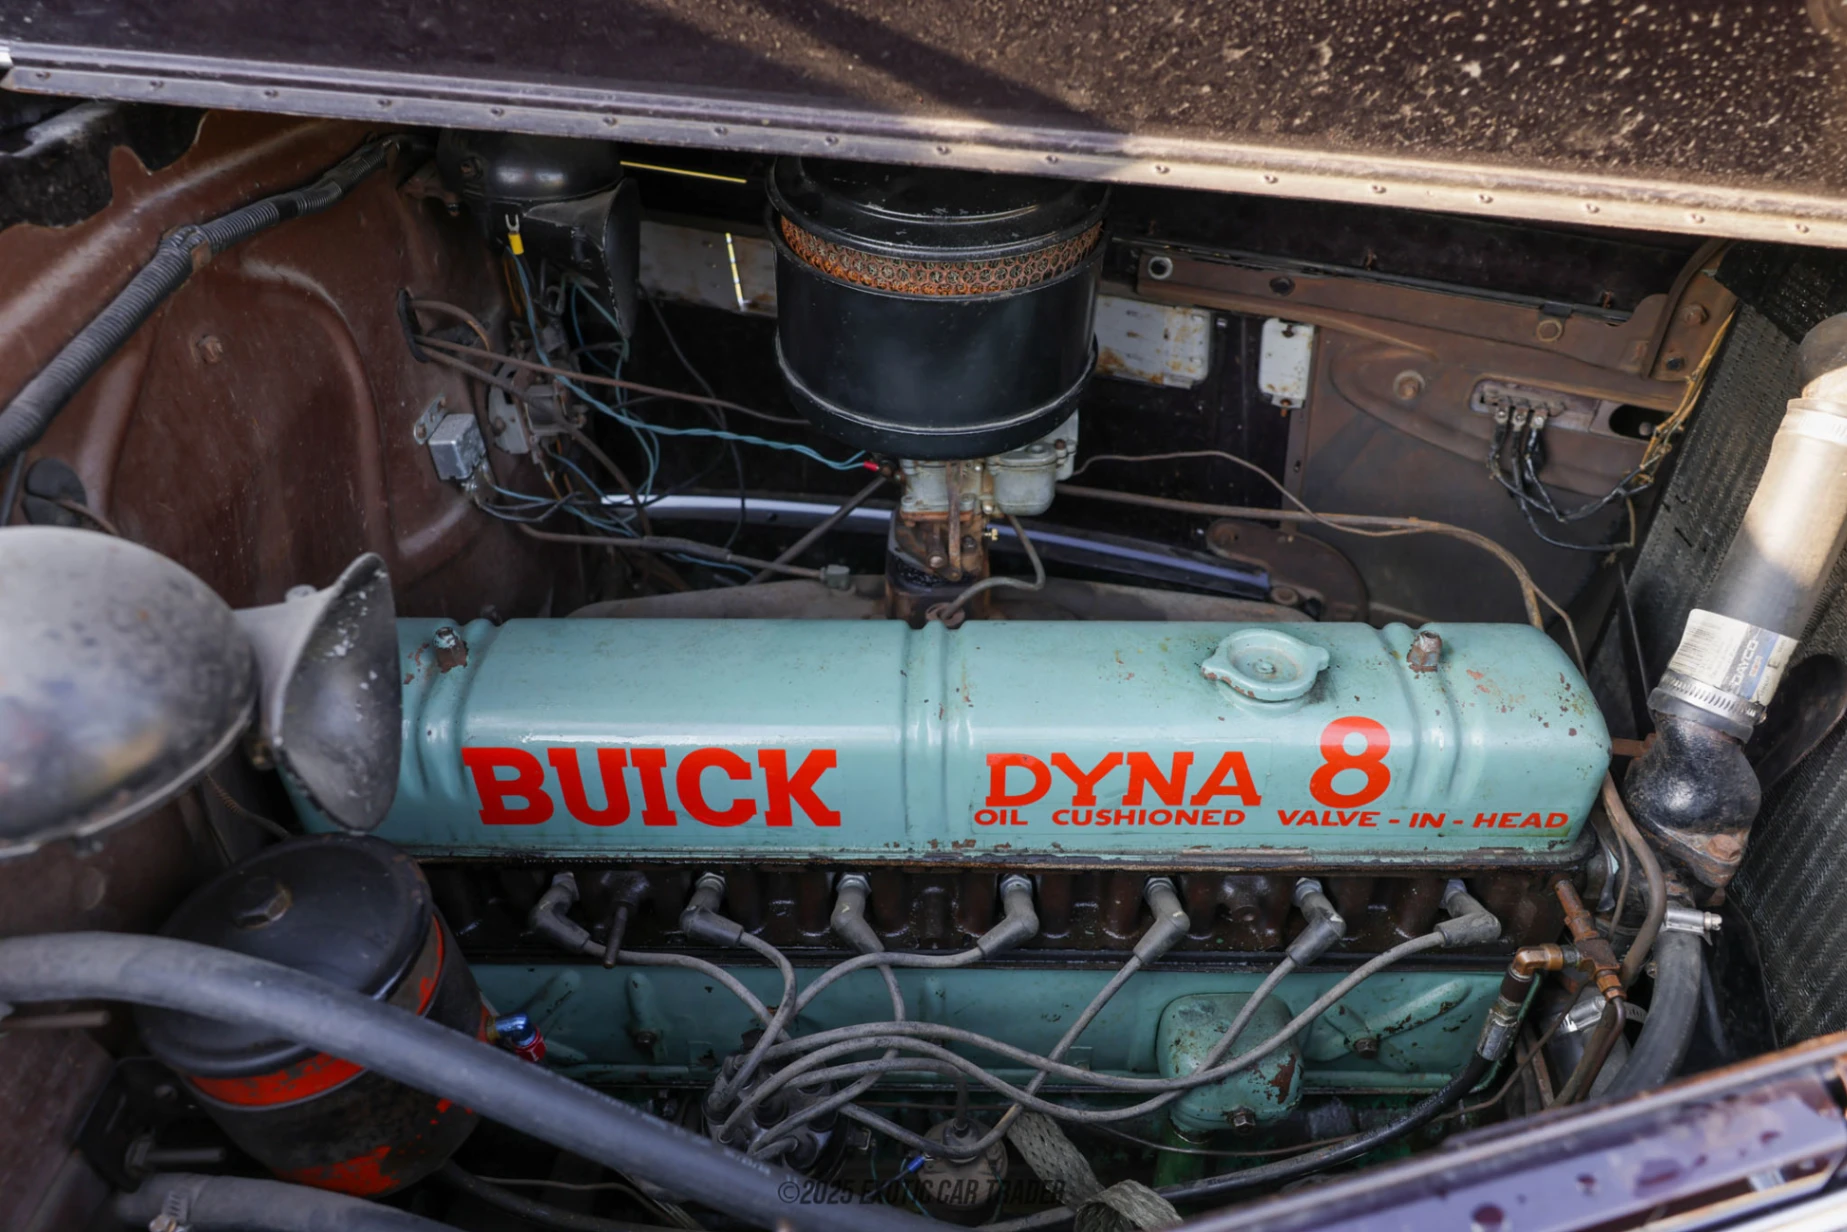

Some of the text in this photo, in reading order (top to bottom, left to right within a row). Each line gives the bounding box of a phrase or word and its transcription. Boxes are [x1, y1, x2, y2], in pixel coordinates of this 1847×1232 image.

[1730, 640, 1759, 686] DAYCO
[461, 747, 841, 827] BUICK
[985, 716, 1391, 808] DYNA 8
[974, 809, 1028, 826] OIL
[1051, 809, 1246, 826] CUSHIONED
